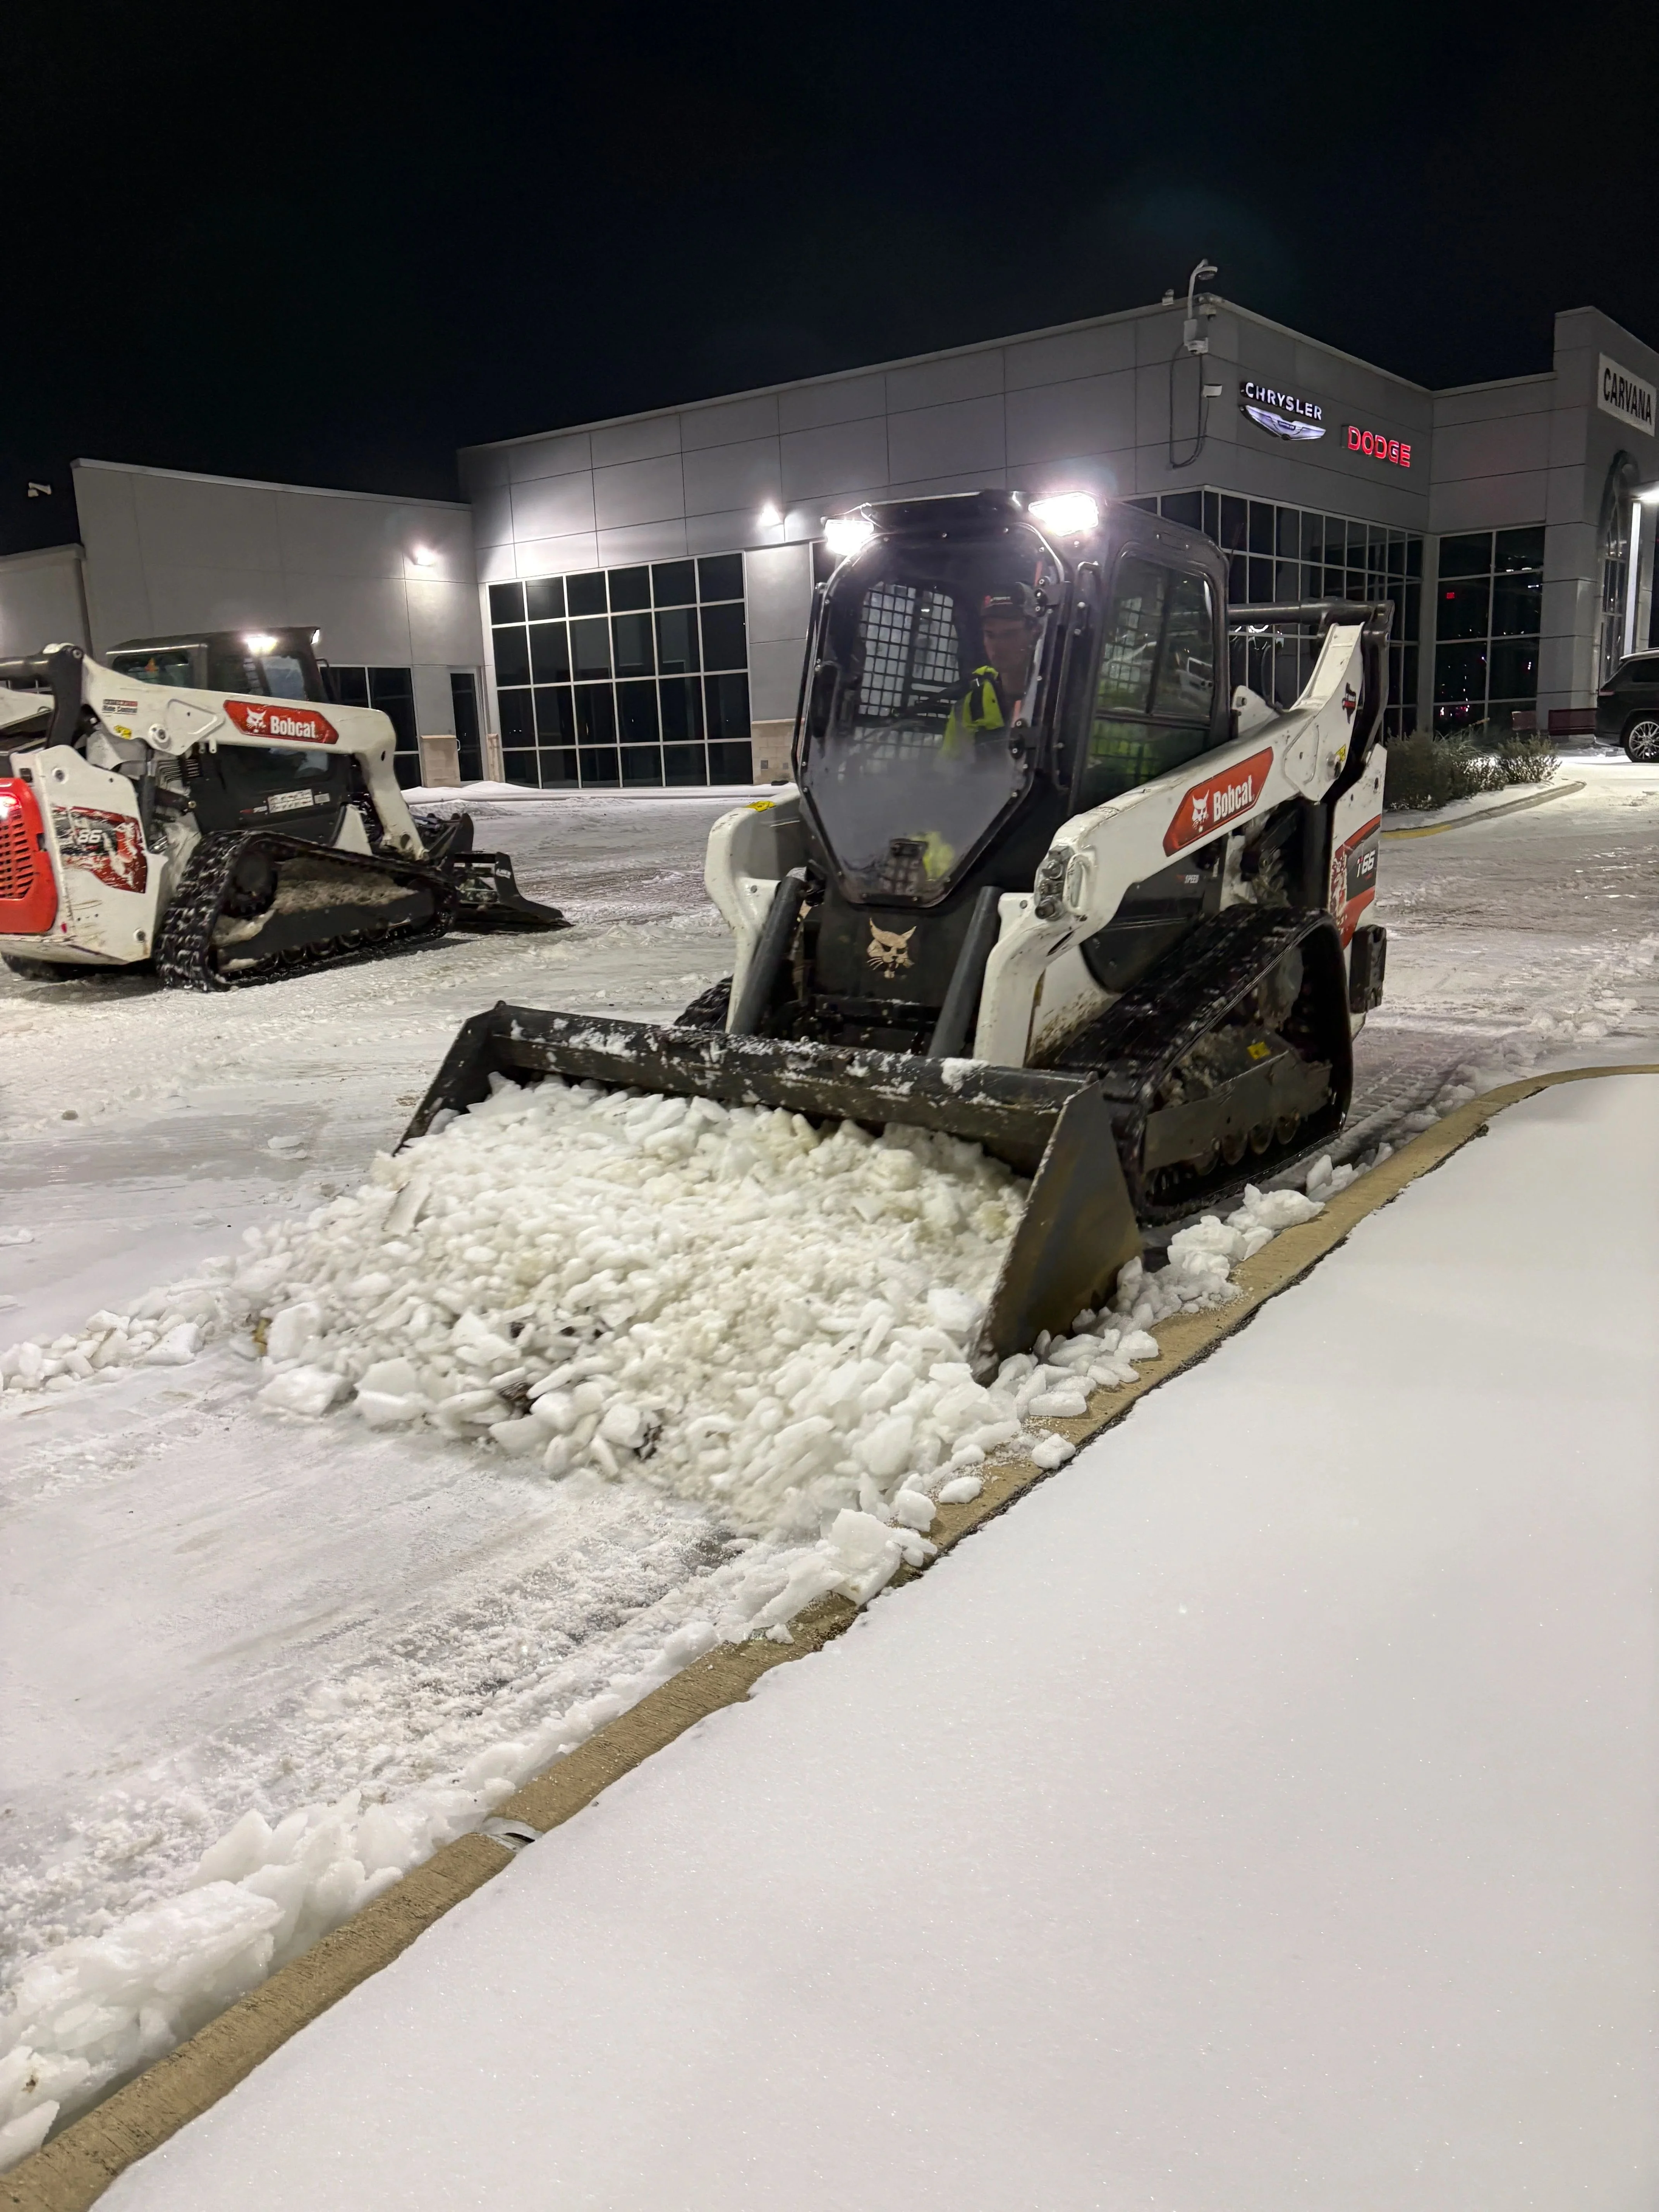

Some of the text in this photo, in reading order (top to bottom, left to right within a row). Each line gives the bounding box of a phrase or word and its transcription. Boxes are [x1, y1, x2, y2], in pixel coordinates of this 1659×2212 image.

[1245, 382, 1322, 421] CHRYSLER
[1604, 368, 1652, 426] CARVANA
[1348, 426, 1411, 468] DODGE
[270, 716, 316, 738] Bobcat
[1213, 775, 1252, 823] Bobcat
[1357, 850, 1376, 878] T66
